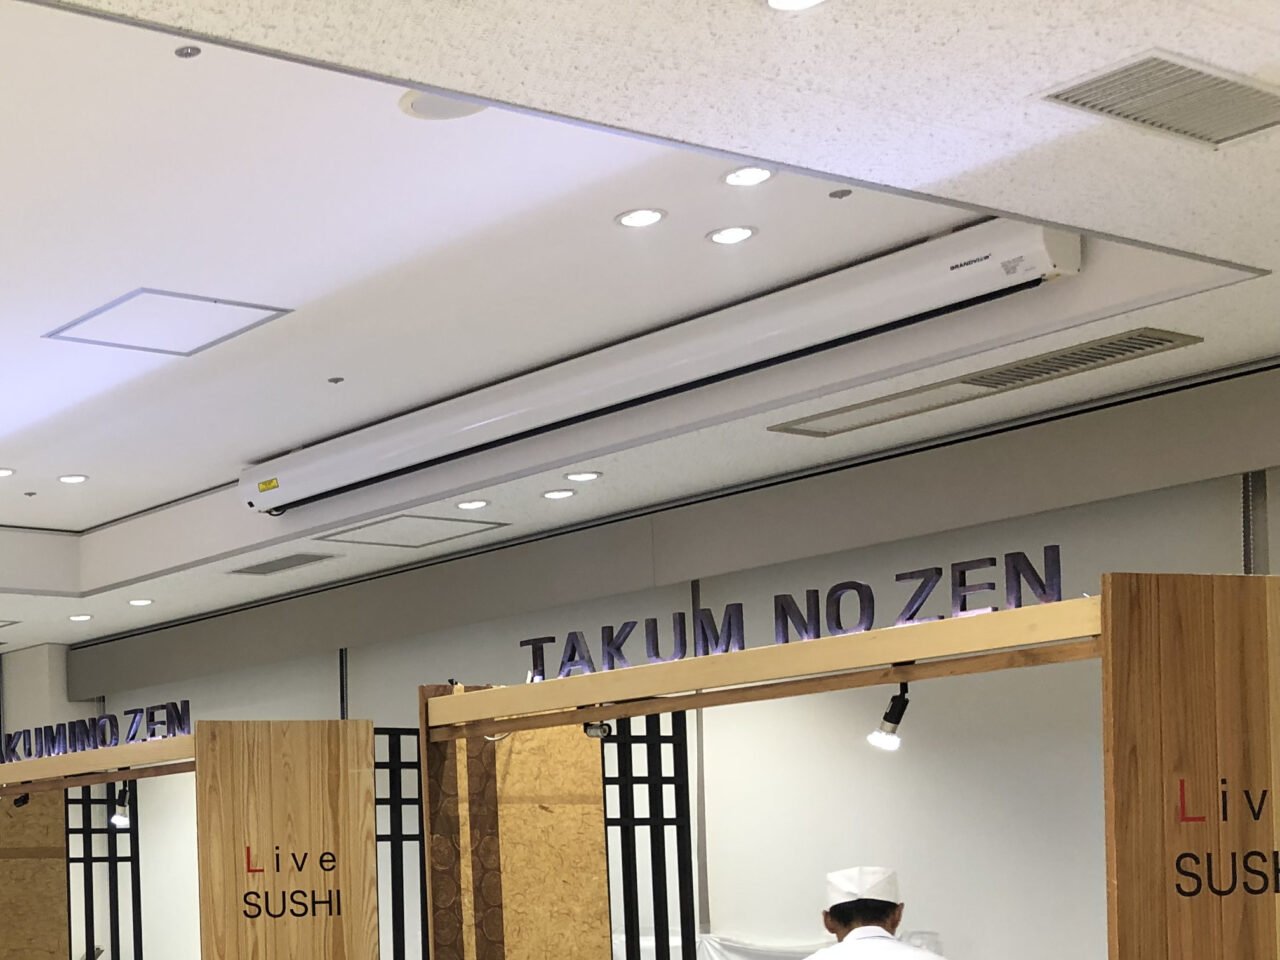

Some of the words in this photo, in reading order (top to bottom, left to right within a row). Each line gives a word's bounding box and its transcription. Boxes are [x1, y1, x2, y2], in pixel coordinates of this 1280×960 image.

[773, 580, 875, 644] NO
[894, 544, 1062, 628] ZEN
[123, 699, 191, 744] ZEN
[245, 846, 337, 873] Live
[243, 889, 341, 919] SUSHI
